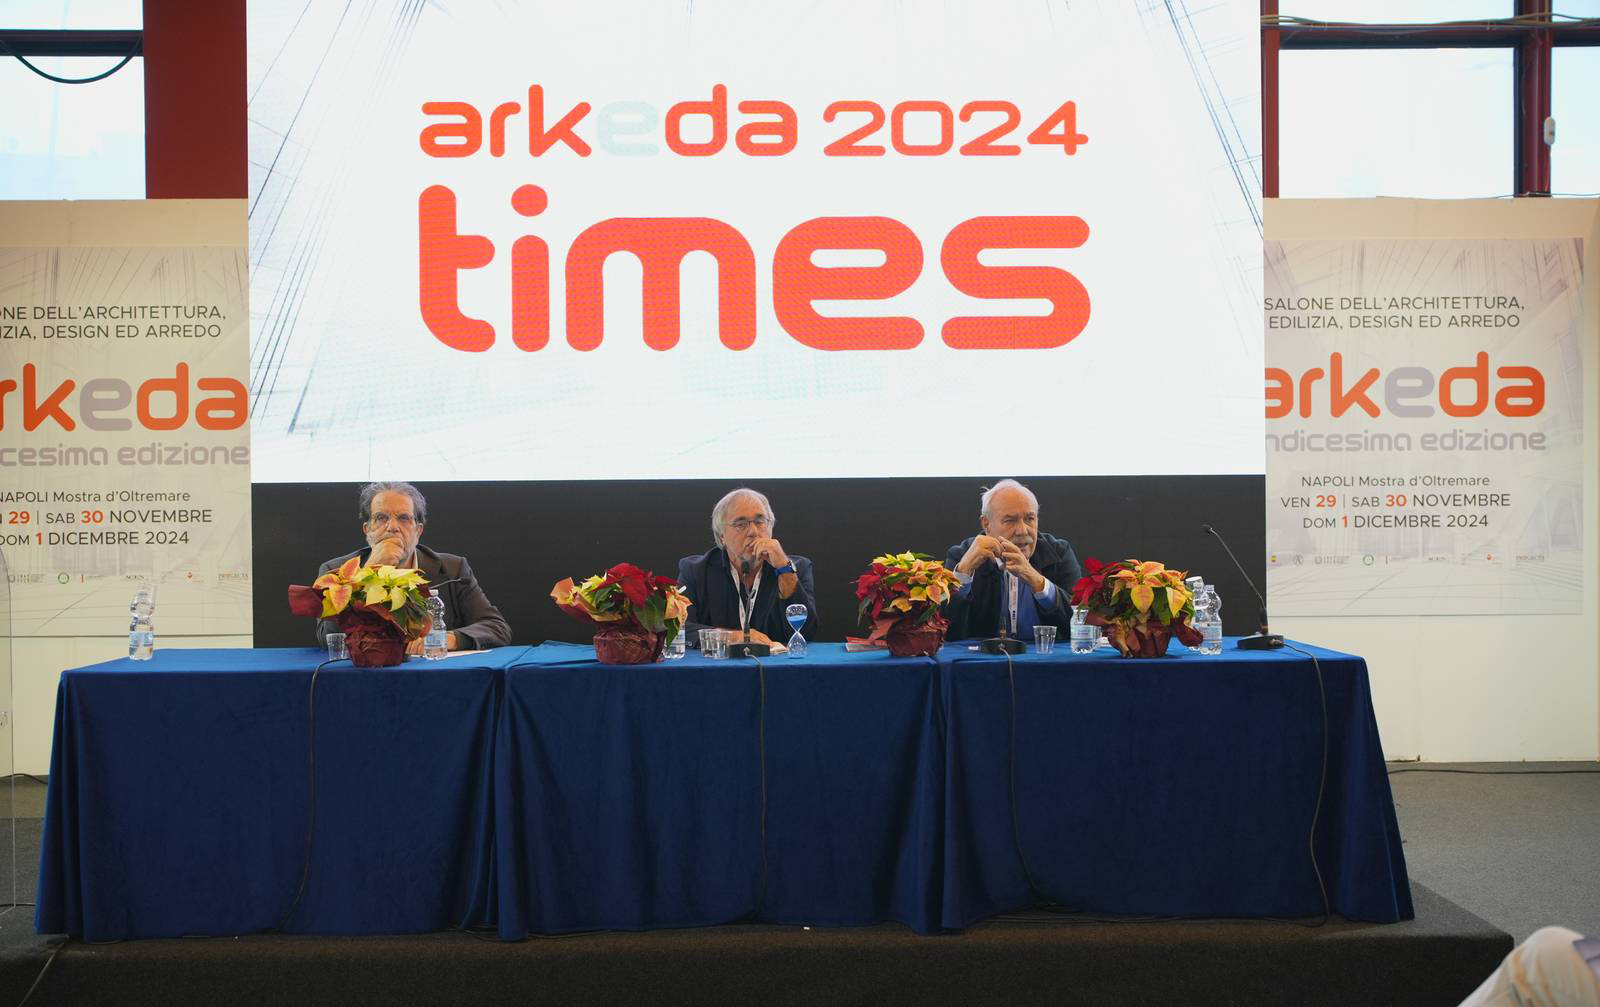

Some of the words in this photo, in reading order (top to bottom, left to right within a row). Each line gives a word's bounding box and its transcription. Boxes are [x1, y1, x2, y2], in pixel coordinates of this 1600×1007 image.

[419, 83, 798, 158] arkeda
[823, 100, 1089, 157] 2024
[418, 184, 1091, 352] times
[1264, 297, 1334, 311] SALONE
[1341, 296, 1525, 311] DELL'ARCHITETTURA,
[0, 307, 27, 320] NE
[33, 305, 226, 320] DELL'ARCHITETTURA,
[1269, 316, 1343, 330] EDILIZIA,
[1350, 315, 1413, 329] DESIGN
[1420, 315, 1441, 328] ED
[1448, 314, 1520, 328] ARREDO
[43, 325, 109, 339] DESIGN
[116, 325, 139, 338] ED
[146, 324, 221, 338] ARREDO
[1421, 429, 1546, 451] edizione
[118, 443, 250, 465] edizione
[1302, 476, 1354, 486] NAPOLI
[1359, 476, 1405, 487] Mostra
[1409, 475, 1490, 486] d'Oltremare
[53, 491, 101, 502] Mostra
[106, 490, 190, 501] d'Oltremare
[1281, 496, 1310, 508] VEN
[1316, 495, 1336, 508] 29
[1352, 496, 1380, 507] SAB
[1386, 495, 1406, 507] 30
[1413, 494, 1511, 506] NOVEMBRE
[9, 512, 30, 524] 29
[46, 512, 75, 524] SAB
[81, 511, 103, 523] 30
[110, 510, 212, 523] NOVEMBRE
[1303, 517, 1336, 528] DOM
[1342, 516, 1348, 528] 1
[1354, 515, 1440, 528] DICEMBRE
[1447, 514, 1488, 527] 2024
[36, 533, 42, 544] 1
[49, 532, 139, 545] DICEMBRE
[146, 531, 189, 544] 2024
